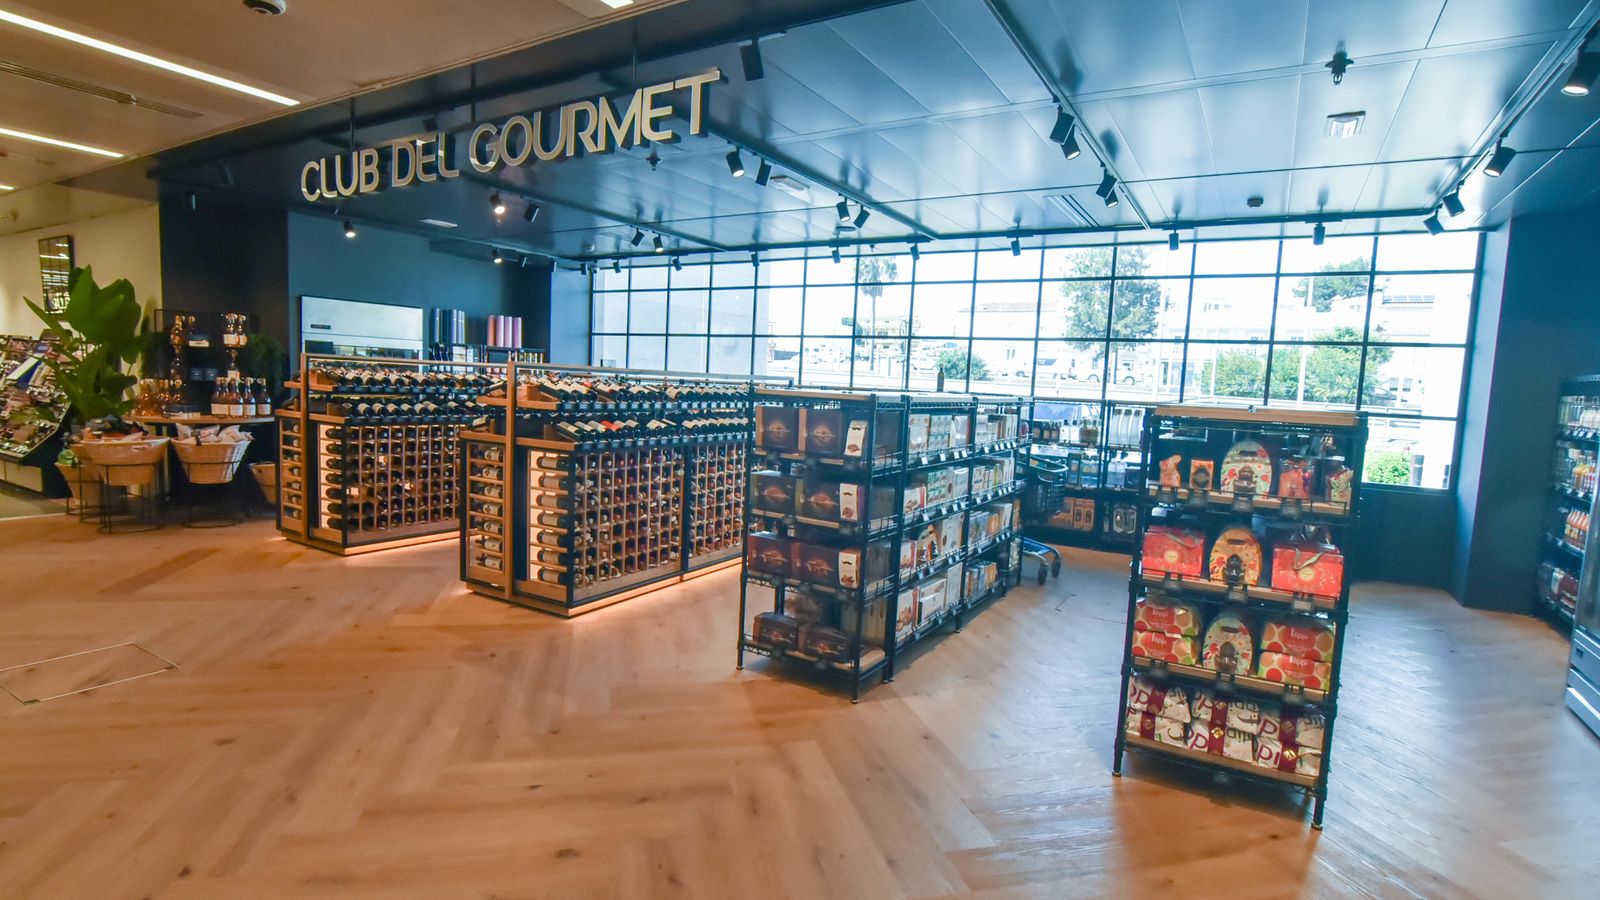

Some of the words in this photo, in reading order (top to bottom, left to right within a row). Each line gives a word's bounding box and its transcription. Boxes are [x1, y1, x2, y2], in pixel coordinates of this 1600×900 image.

[301, 148, 380, 202] CLUB
[391, 131, 460, 188] DEL
[469, 68, 721, 173] GOURMET
